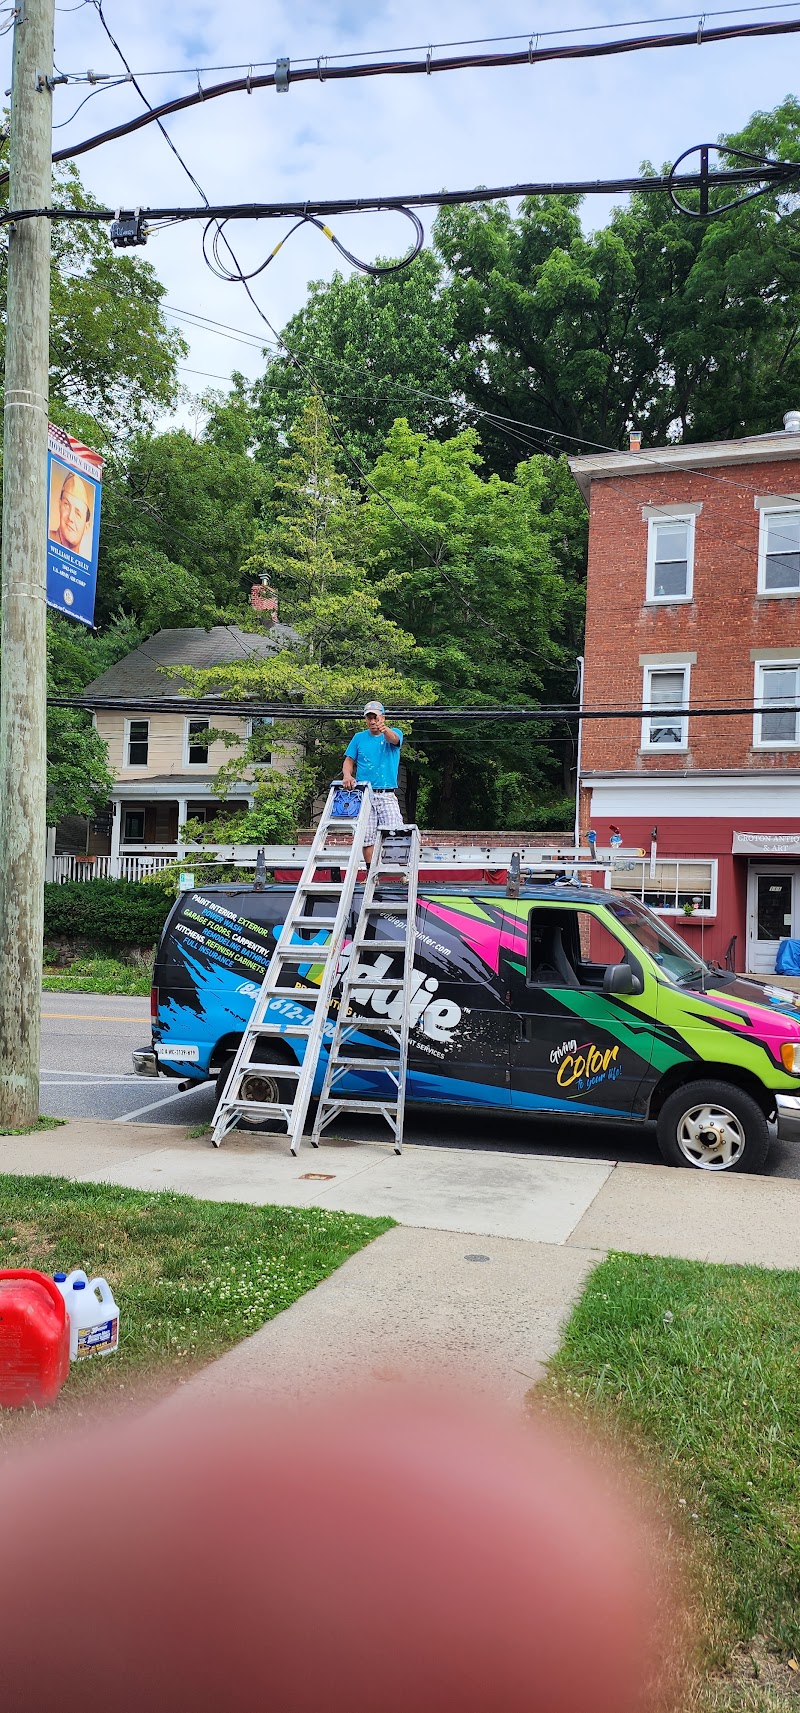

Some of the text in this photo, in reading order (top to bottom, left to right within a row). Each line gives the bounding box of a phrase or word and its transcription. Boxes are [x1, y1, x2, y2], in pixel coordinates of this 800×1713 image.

[50, 545, 70, 561] WILLIAM
[737, 834, 800, 843] CROTON ANTIQ
[763, 844, 789, 852] & ART
[191, 894, 212, 908] PAINT
[208, 902, 238, 922] INTERIOR,
[201, 908, 224, 924] POWER
[183, 908, 270, 958] GARAGE FLOORS, CARPENTRY,
[201, 927, 242, 952] REMODELING
[174, 923, 266, 976] KITCHENS, REFINISH CABINETS,
[182, 936, 235, 968] FULL INSURANCE
[415, 1040, 446, 1060] SERVICES
[549, 1039, 577, 1065] Giving
[556, 1044, 620, 1087] Color
